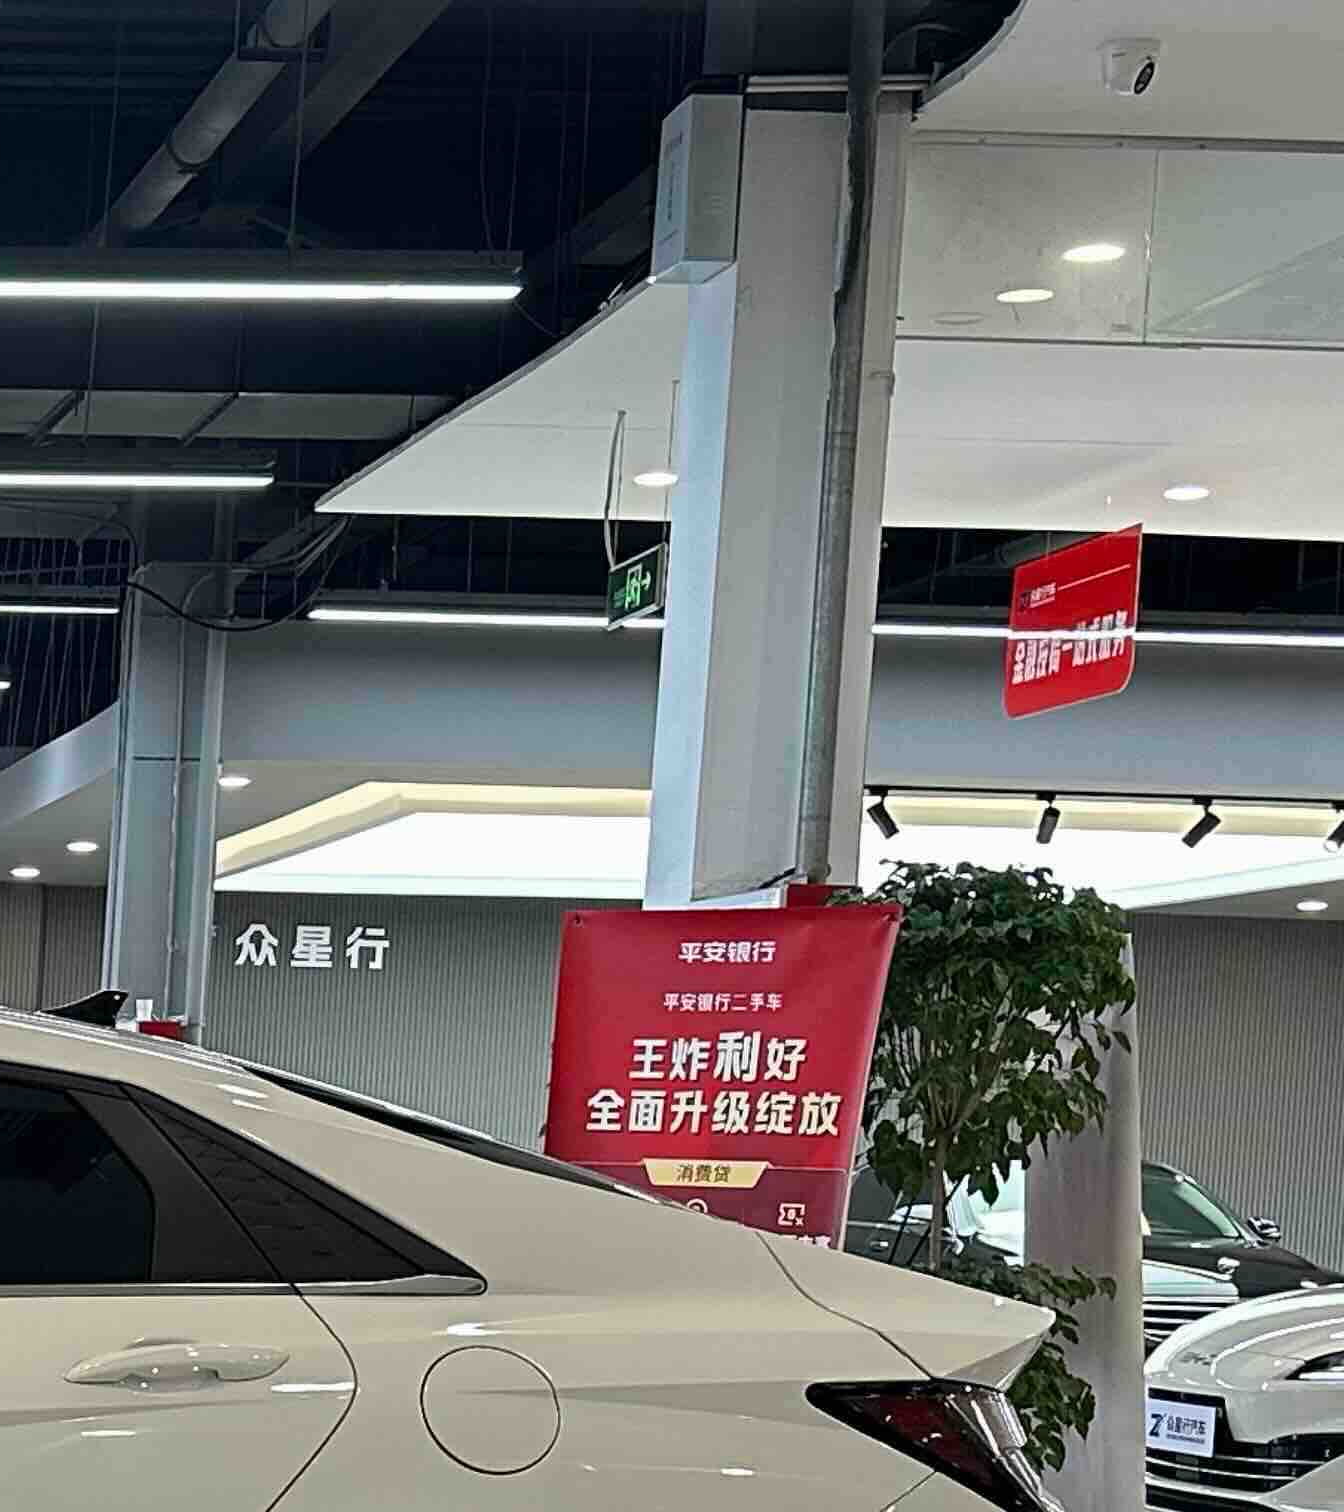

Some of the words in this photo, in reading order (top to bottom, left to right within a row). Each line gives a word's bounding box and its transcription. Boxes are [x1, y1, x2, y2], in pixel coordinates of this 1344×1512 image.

[234, 922, 390, 970] 众星行
[678, 940, 777, 965] 平安银行
[663, 992, 783, 1013] 平安银行二手车
[628, 1030, 808, 1083] 王炸利好
[585, 1088, 842, 1137] 全面升级绽放
[675, 1164, 732, 1184] 消费贷
